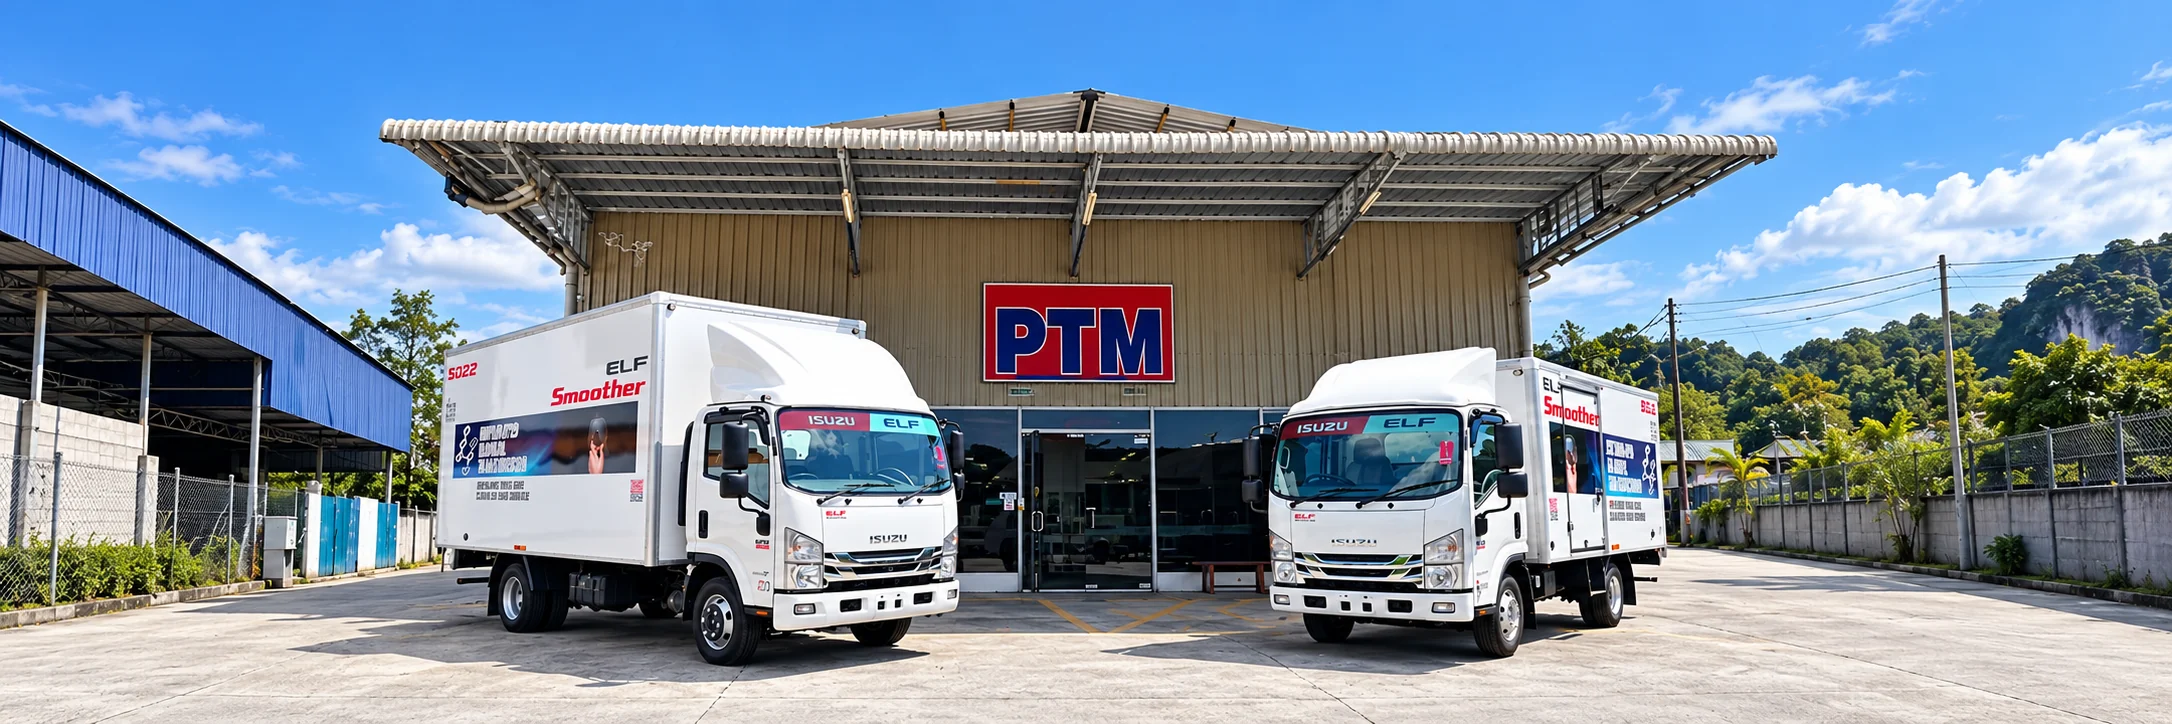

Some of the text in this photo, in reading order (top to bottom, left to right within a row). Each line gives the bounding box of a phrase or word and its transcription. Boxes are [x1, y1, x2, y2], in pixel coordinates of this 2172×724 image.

[995, 306, 1163, 375] PTM
[606, 355, 649, 375] ELF
[550, 379, 646, 406] Smoother
[807, 415, 855, 426] ISUZU
[883, 418, 920, 429] ELF
[1383, 417, 1436, 429] ELF
[1296, 421, 1348, 434] ISUZU
[869, 534, 907, 544] ISUZU
[1331, 539, 1377, 547] ISUZU
